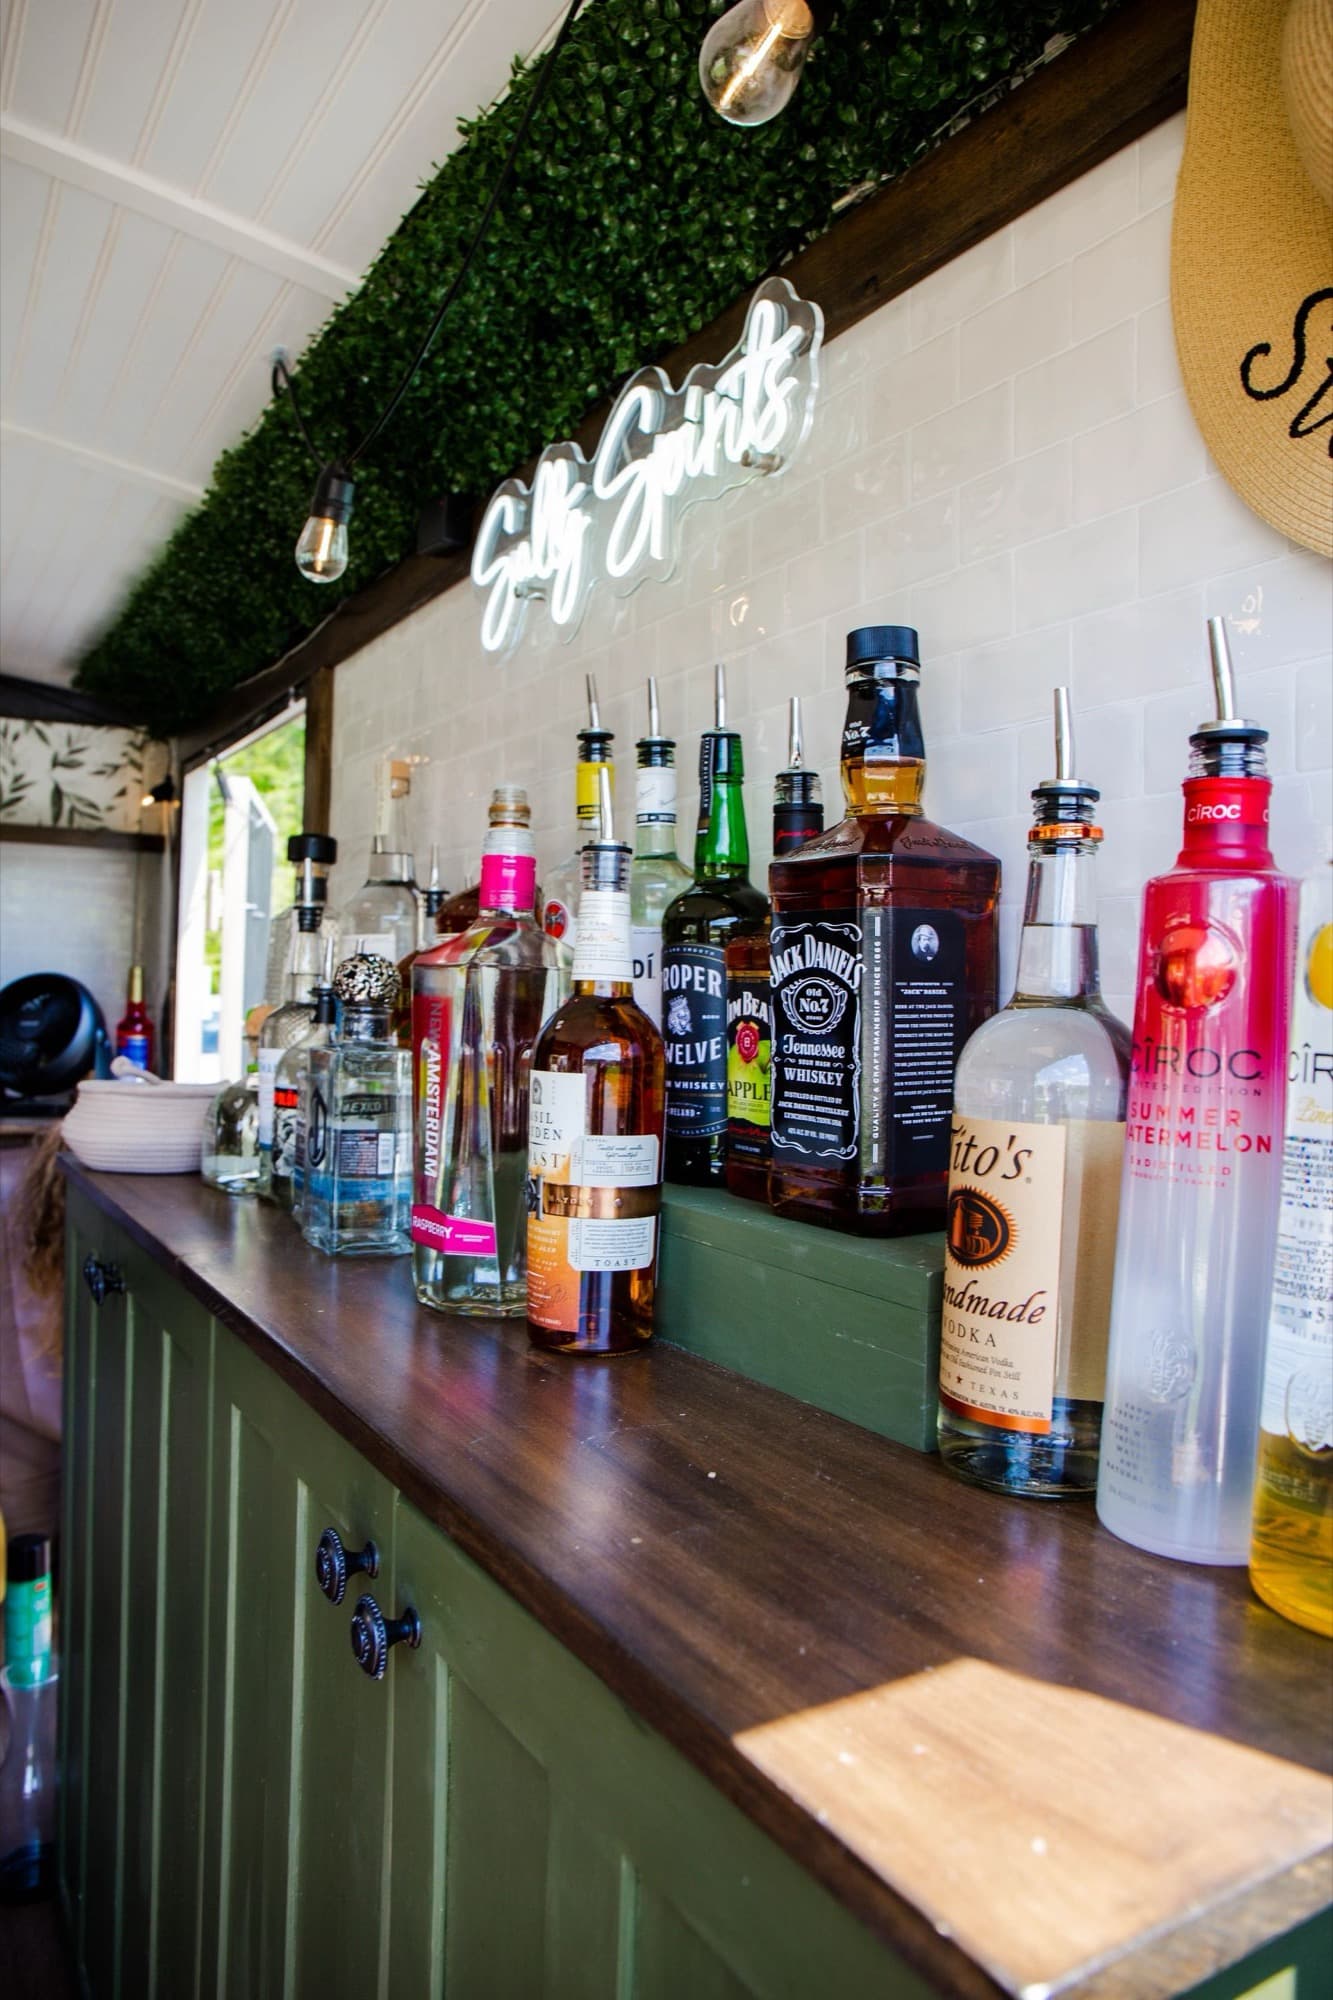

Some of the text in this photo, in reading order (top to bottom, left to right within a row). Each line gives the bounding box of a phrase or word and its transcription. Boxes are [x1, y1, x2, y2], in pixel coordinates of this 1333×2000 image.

[471, 298, 806, 651] Salty Spirits
[1187, 803, 1242, 822] CÎROC
[770, 933, 869, 990] JACK DANIEL'S
[806, 988, 822, 997] Old
[727, 997, 742, 1021] IM
[799, 997, 829, 1014] No.7
[783, 1034, 846, 1058] Tennessee
[674, 1080, 725, 1090] WHISKEY
[784, 1067, 844, 1087] WHISKEY
[424, 1051, 442, 1178] AMSTERDAM
[1130, 1101, 1242, 1128] SUMMER
[594, 1259, 637, 1267] TOAST
[970, 1381, 1020, 1400] TEXAS
